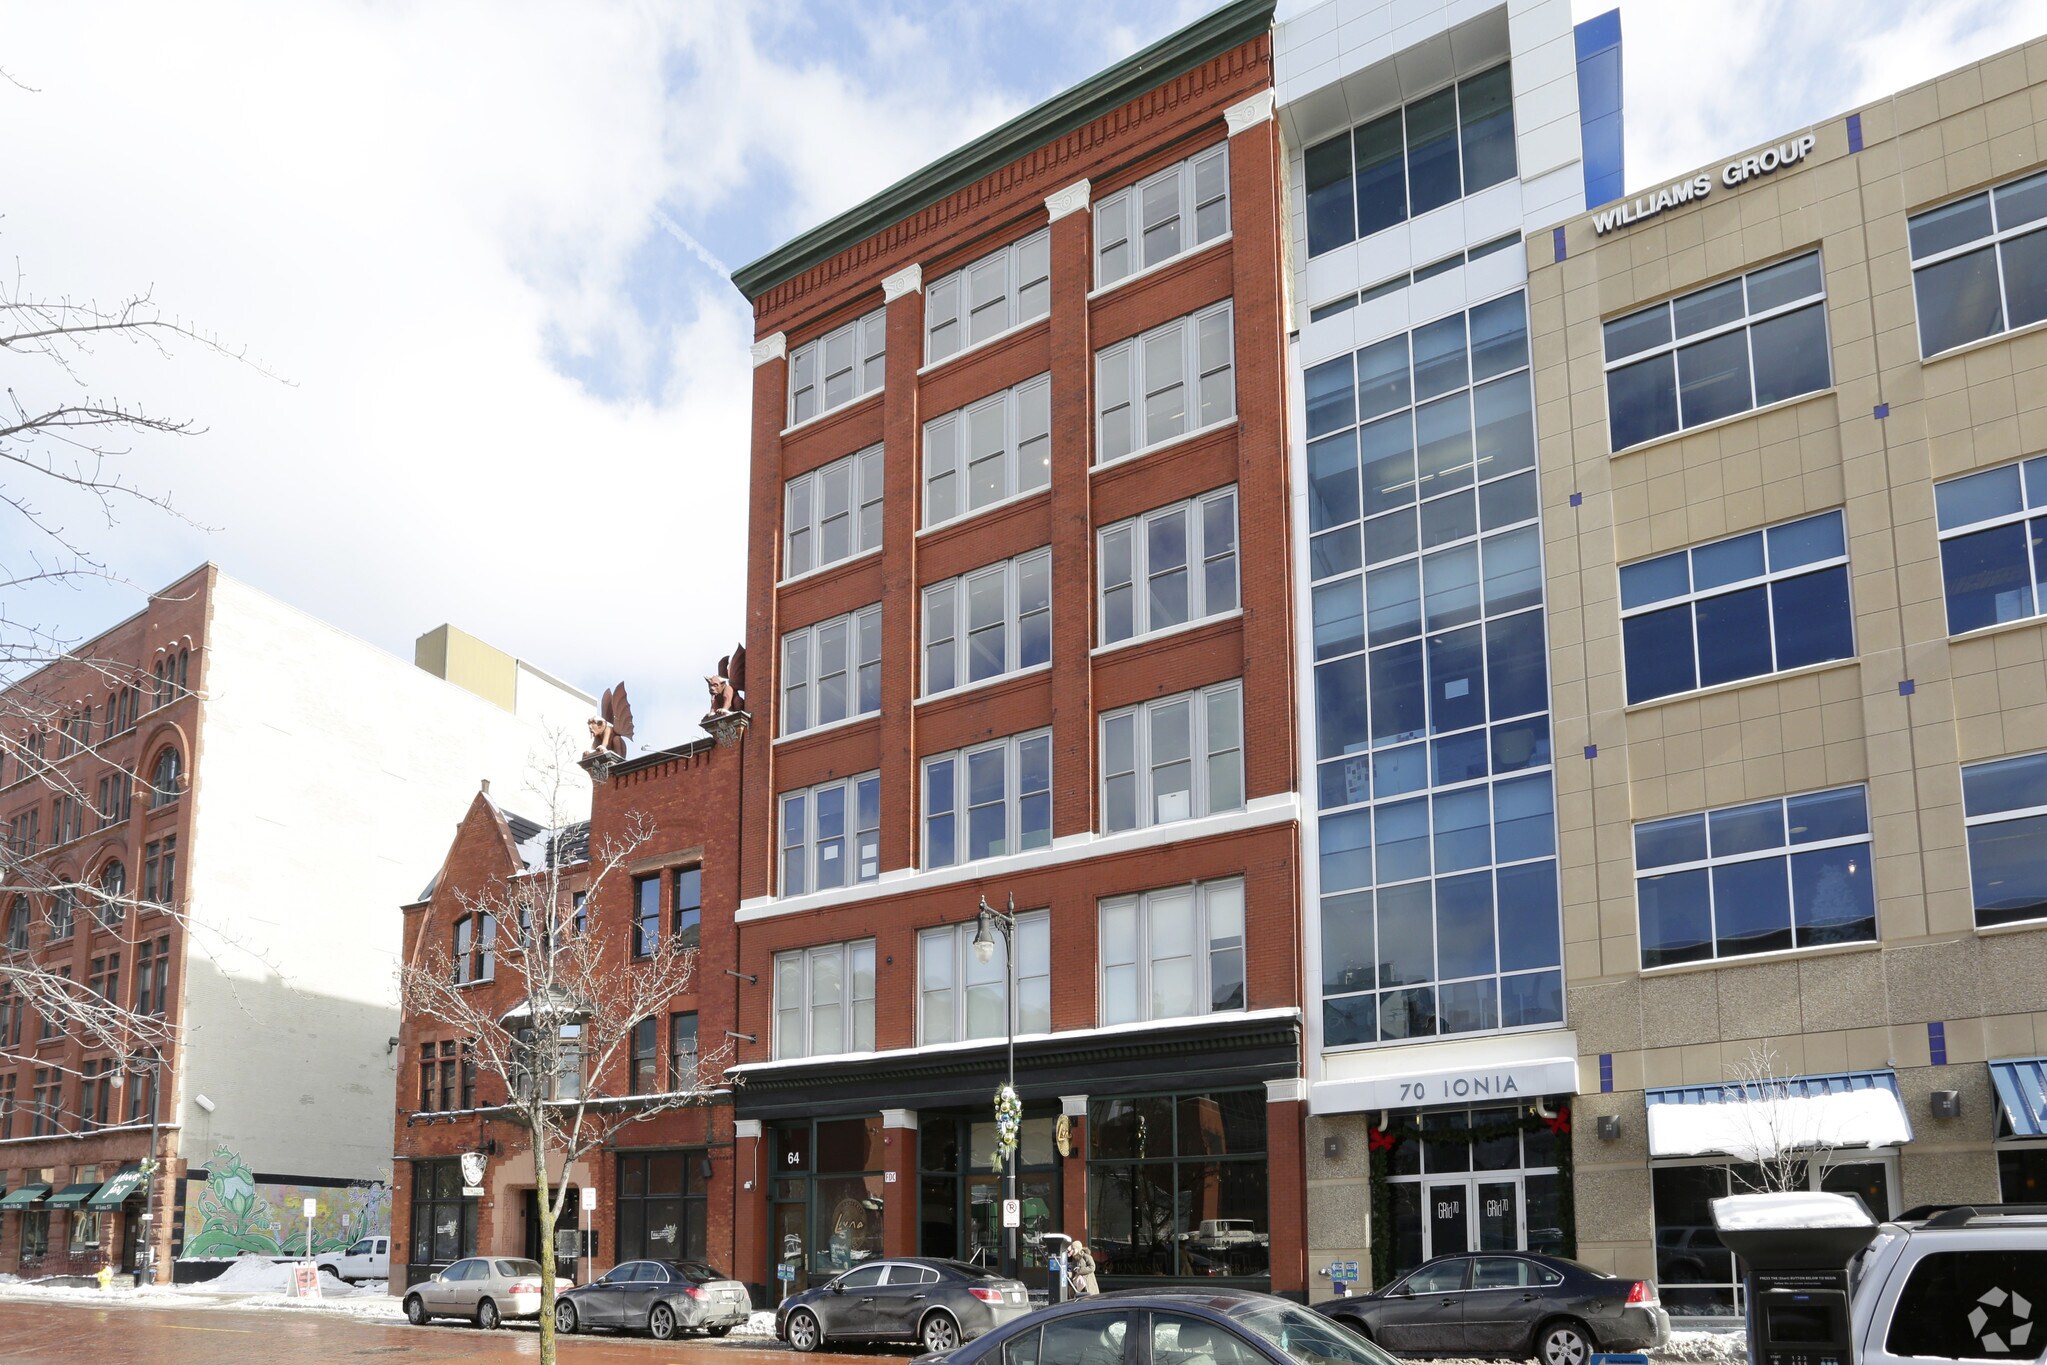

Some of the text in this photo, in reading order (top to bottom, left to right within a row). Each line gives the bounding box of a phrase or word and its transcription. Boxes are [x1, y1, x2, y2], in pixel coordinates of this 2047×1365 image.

[1592, 134, 1815, 234] WILLIAMS GROUP
[1400, 1074, 1519, 1101] 70 IONIA
[788, 1152, 800, 1164] 64
[834, 1213, 864, 1233] Luna
